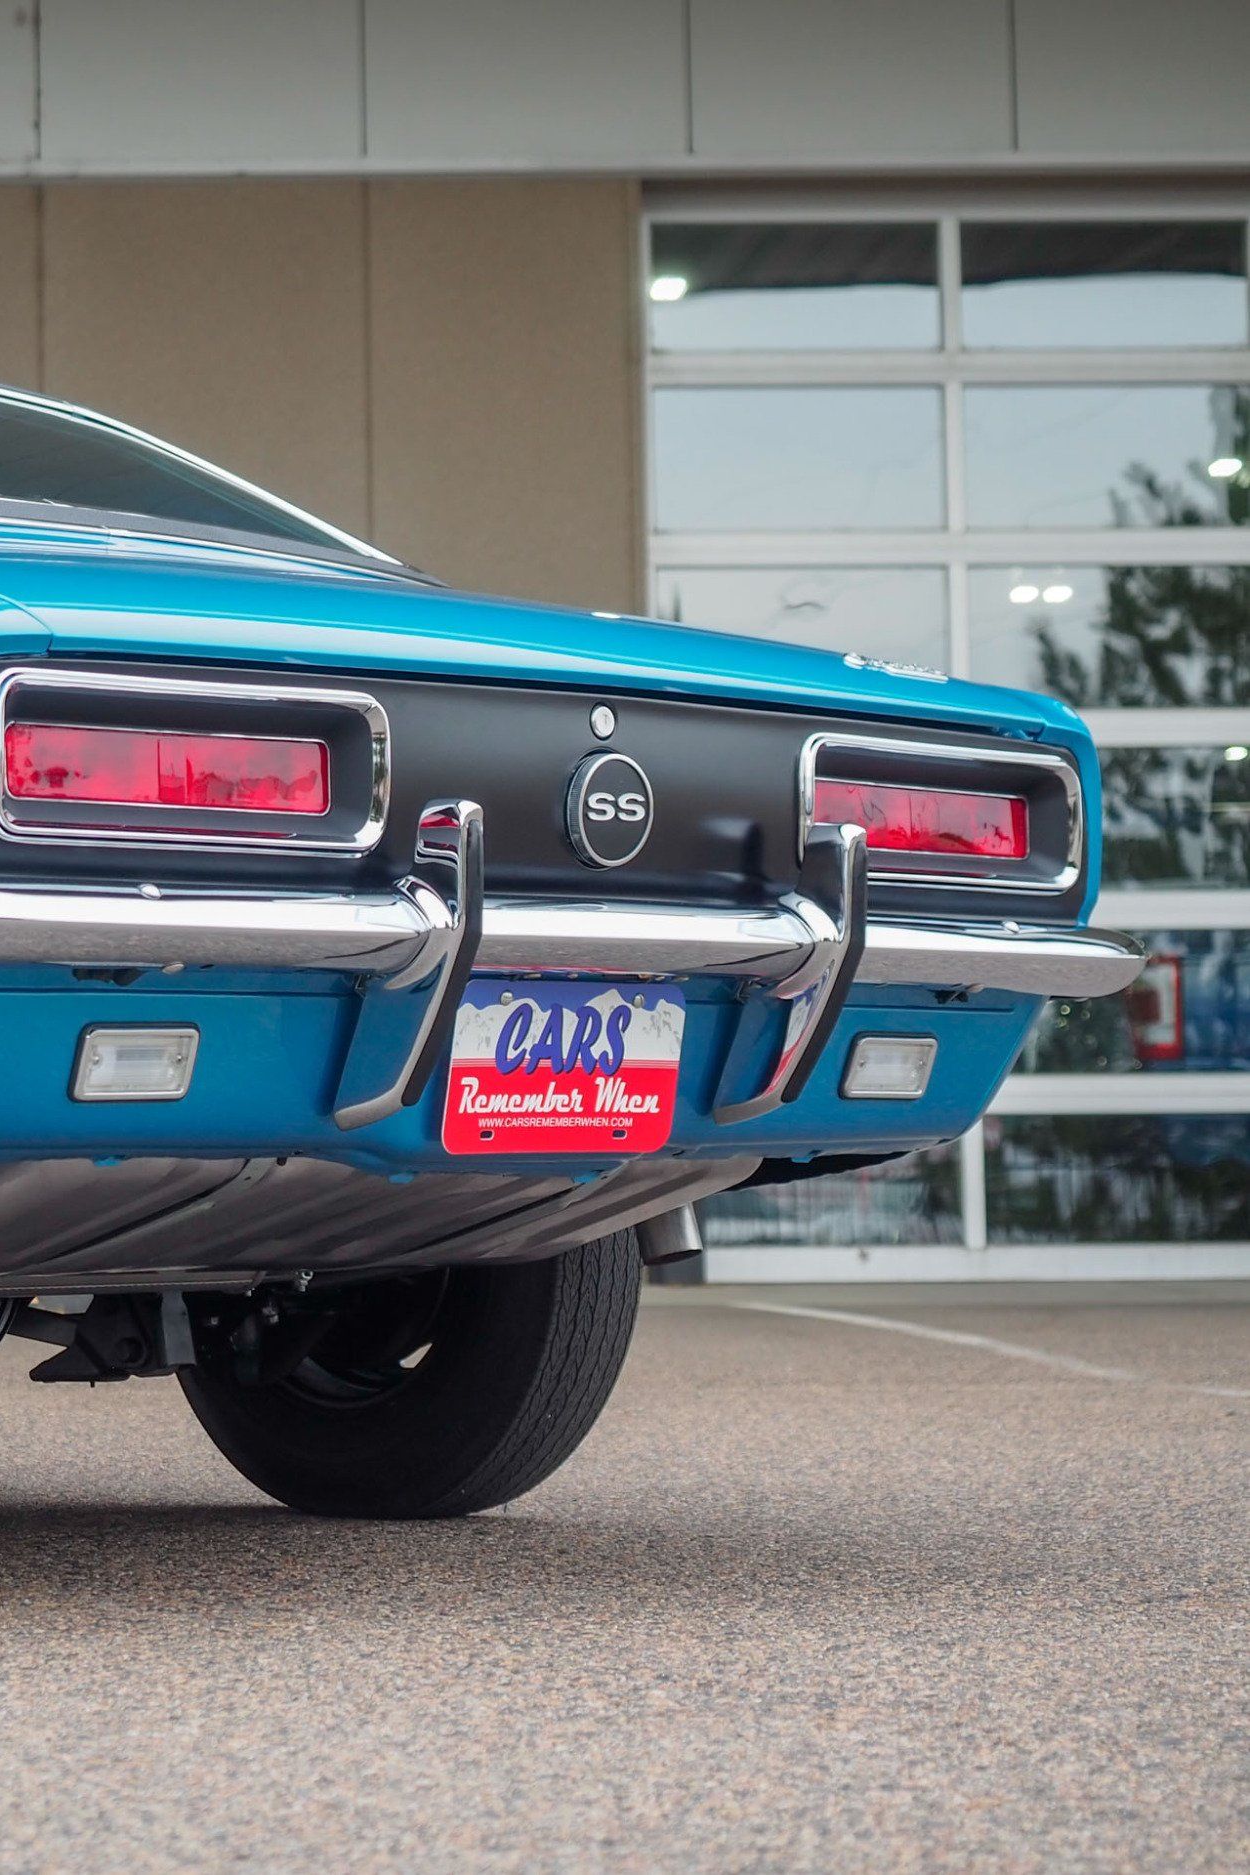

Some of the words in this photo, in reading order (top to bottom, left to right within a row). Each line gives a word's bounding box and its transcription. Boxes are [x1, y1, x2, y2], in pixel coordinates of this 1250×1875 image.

[587, 792, 646, 822] SS
[495, 1003, 632, 1076] CARS
[458, 1077, 584, 1114] Remember
[594, 1077, 660, 1114] When
[478, 1116, 633, 1128] WWW.CARSREMEMBERWHEN.COM
